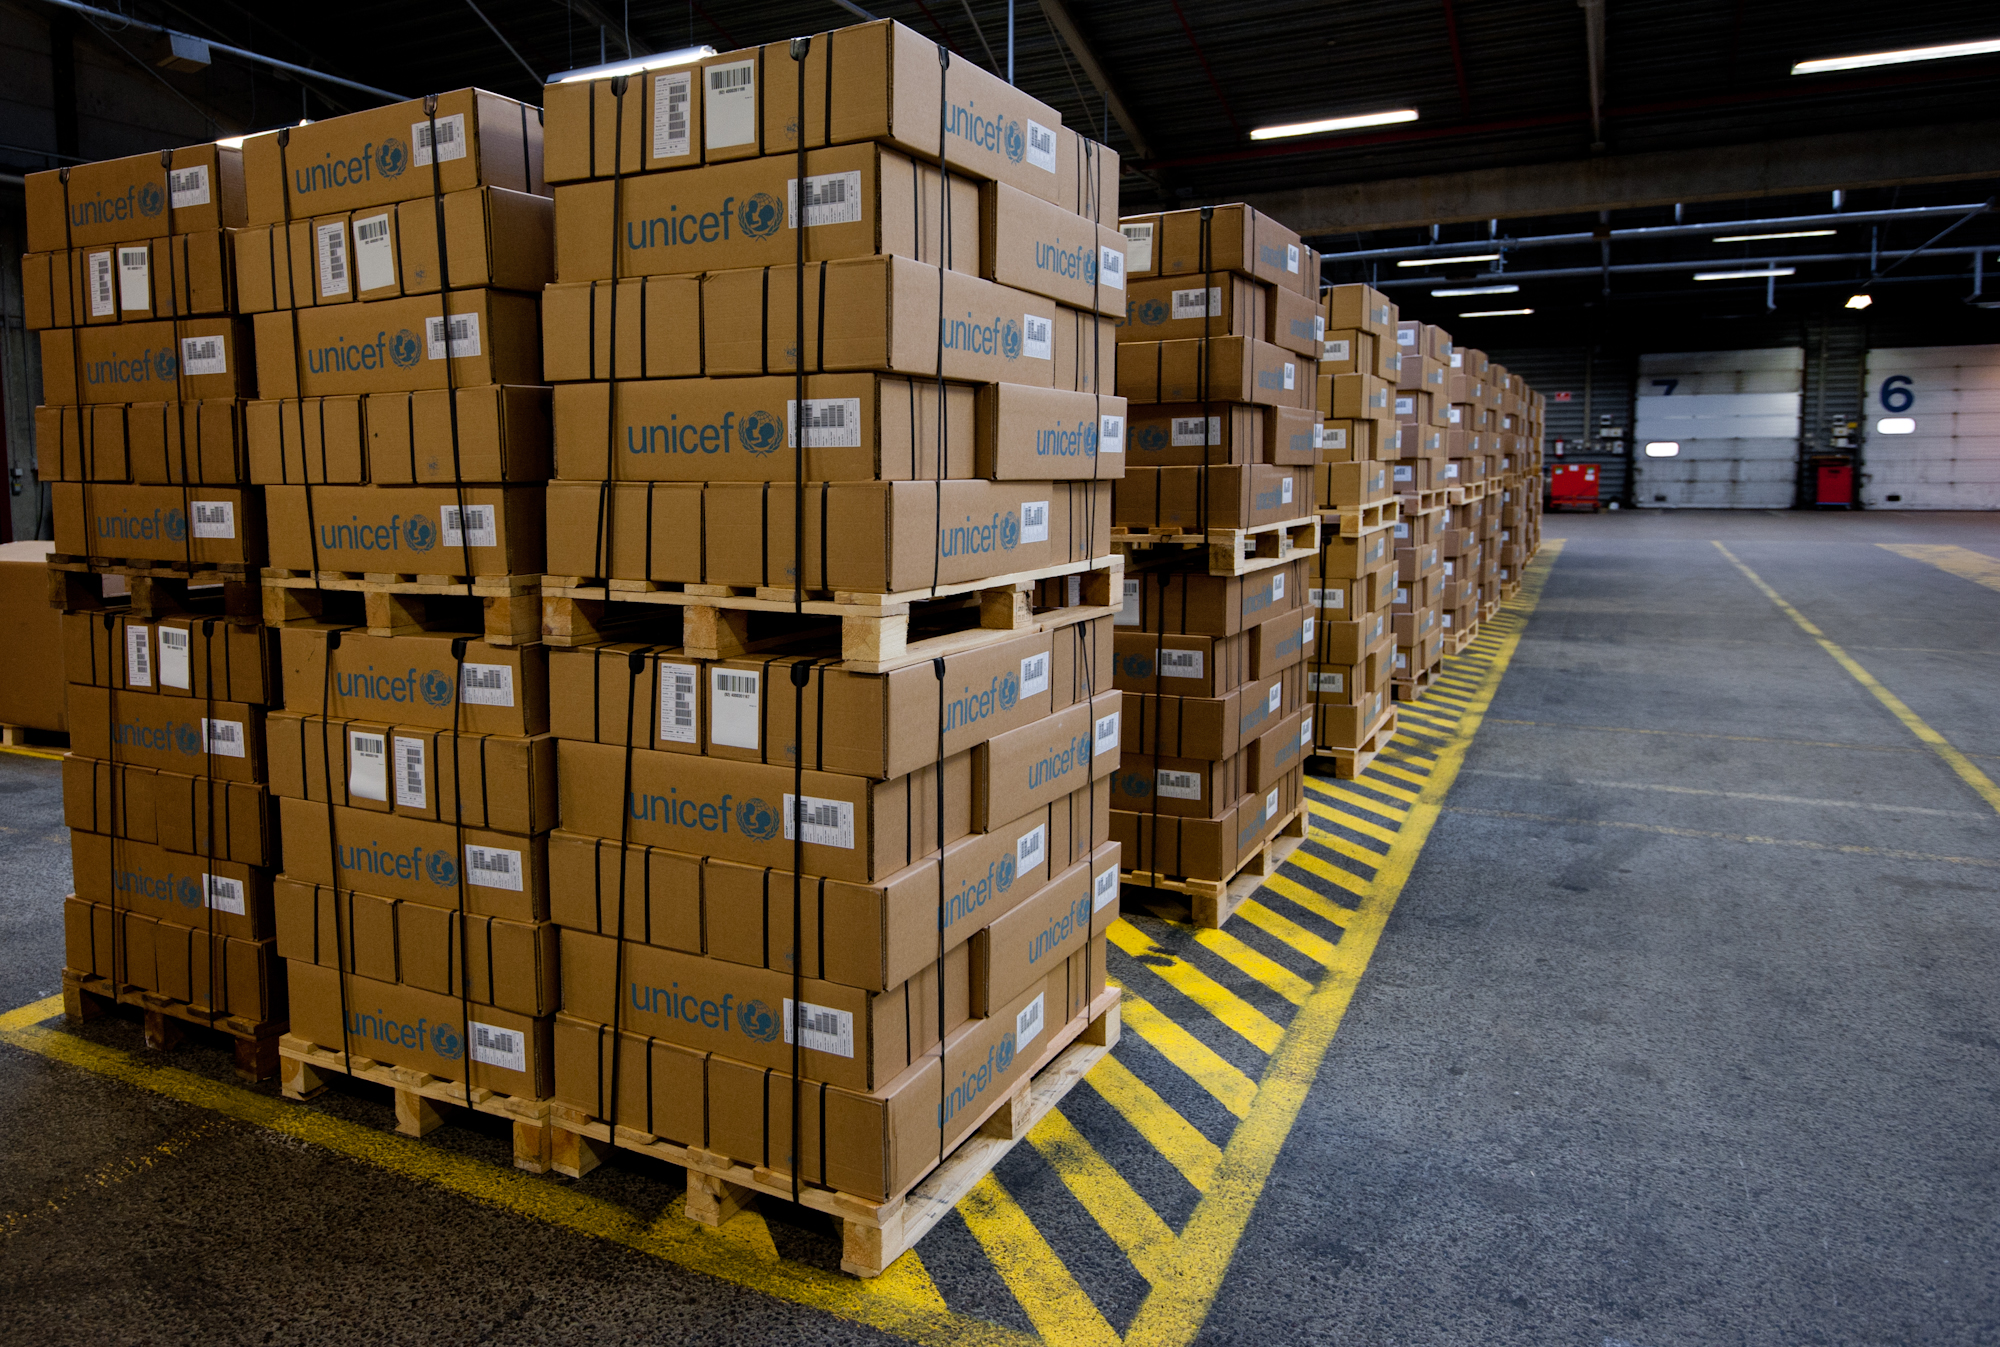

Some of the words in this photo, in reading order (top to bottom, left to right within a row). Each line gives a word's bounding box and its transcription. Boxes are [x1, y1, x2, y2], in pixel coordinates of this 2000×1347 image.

[943, 99, 1004, 154] unicef
[295, 143, 372, 194] unicef
[71, 185, 136, 226] unicef
[627, 196, 735, 250] unicef
[1036, 237, 1083, 280] unicef
[309, 331, 386, 373] unicef
[942, 311, 1001, 356] unicef
[87, 349, 152, 384] unicef
[1881, 375, 1914, 413] 6
[627, 411, 735, 454] unicef
[1036, 420, 1084, 457] unicef
[97, 508, 161, 540] unicef
[321, 515, 400, 551] unicef
[941, 513, 999, 558] unicef
[337, 665, 417, 703] unicef
[942, 675, 999, 734] unicef
[111, 717, 173, 751] unicef
[1028, 735, 1077, 790] unicef
[629, 787, 732, 834] unicef
[339, 840, 423, 881] unicef
[113, 866, 174, 901] unicef
[937, 862, 995, 930] unicef
[1028, 900, 1077, 964] unicef
[631, 981, 733, 1032] unicef
[345, 1008, 426, 1051] unicef
[937, 1044, 995, 1130] unicef
